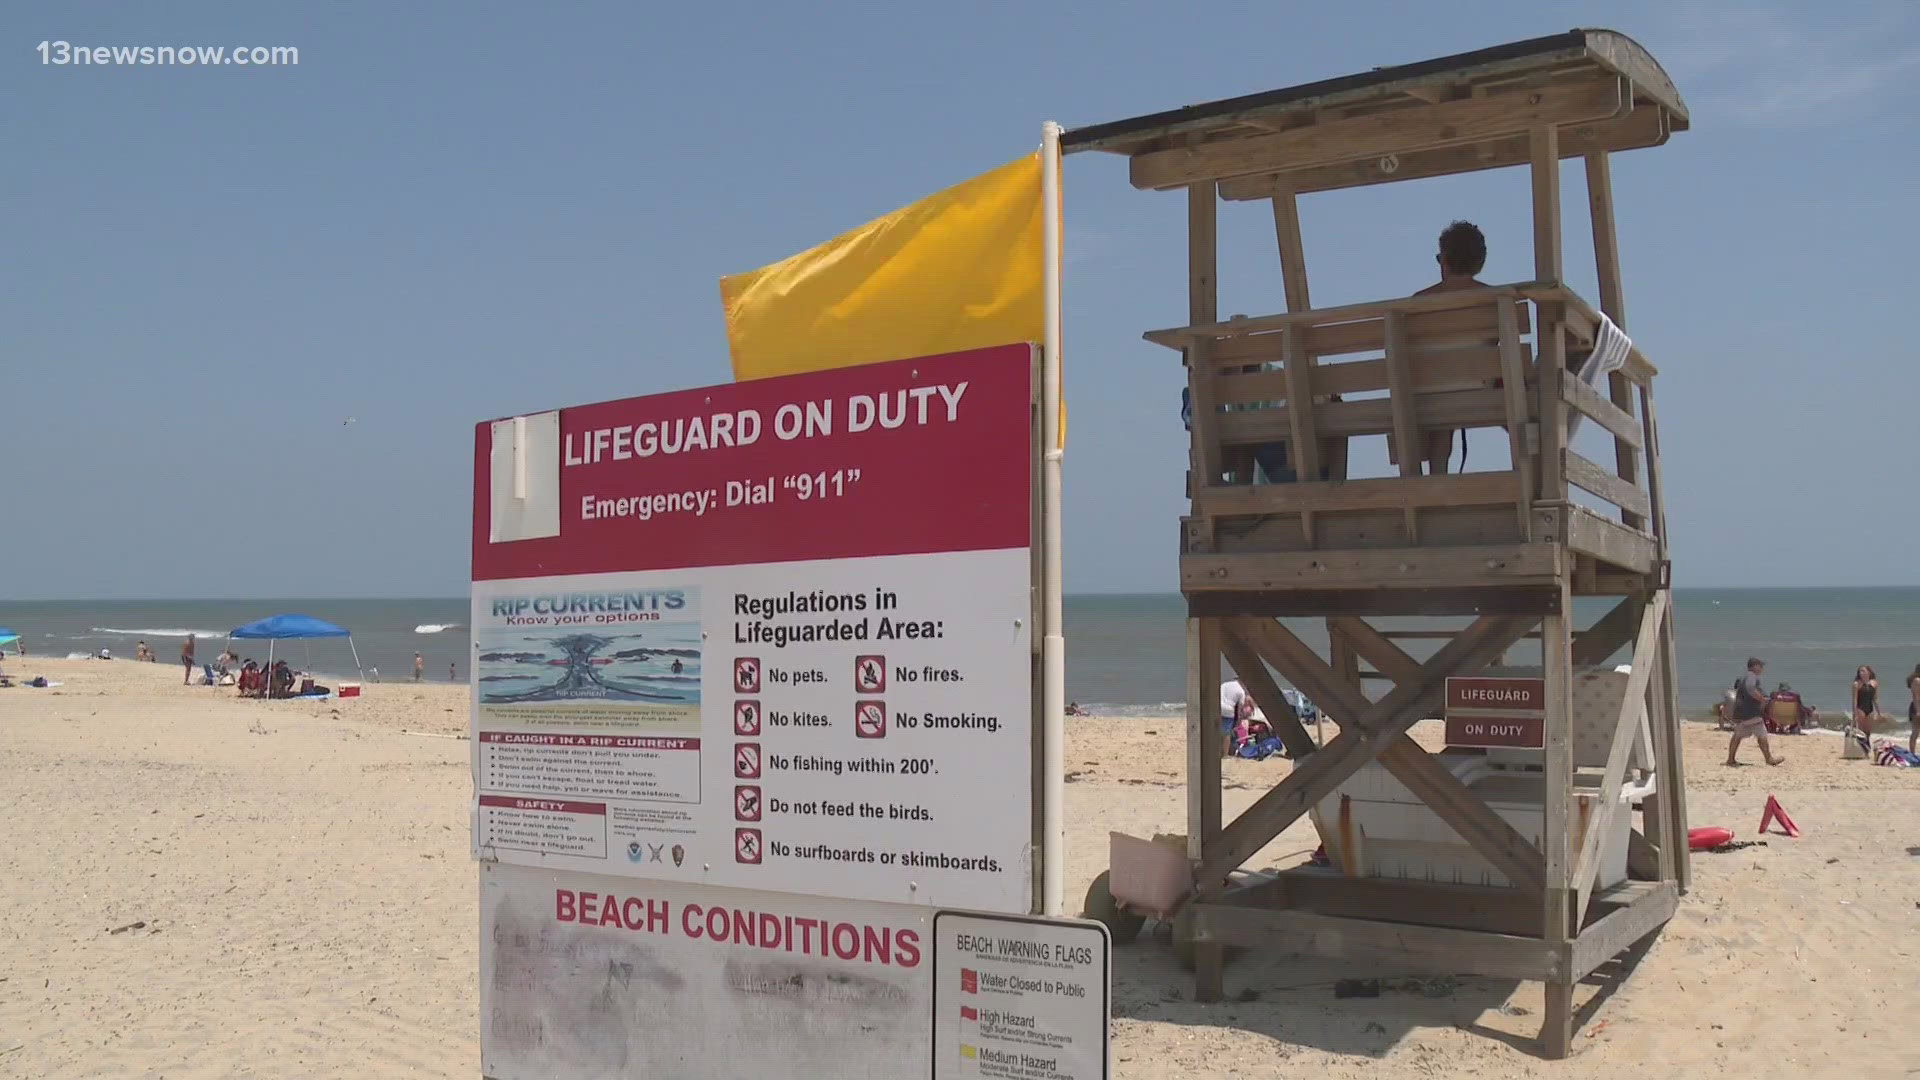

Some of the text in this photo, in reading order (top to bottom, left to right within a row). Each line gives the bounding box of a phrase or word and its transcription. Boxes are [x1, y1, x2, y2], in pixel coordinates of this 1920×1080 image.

[564, 381, 969, 467] LIFEGUARD ON DUTY
[581, 487, 718, 520] Emergency:
[726, 477, 774, 507] Dial
[493, 590, 686, 617] RIP CURRENTS
[734, 587, 897, 619] Regulations in
[507, 611, 660, 626] Know your options
[735, 617, 943, 648] Lifeguarded Area:
[769, 668, 828, 686] No pets.
[895, 666, 964, 682] No fires.
[1461, 689, 1530, 701] LIFEGUARD
[769, 711, 832, 727] No kites.
[896, 713, 1002, 732] No Smoking.
[1465, 724, 1523, 736] ON DUTY
[505, 735, 556, 743] CAUGHT
[577, 737, 586, 745] A
[590, 738, 613, 746] RIP
[617, 739, 687, 748] CURRENT
[769, 755, 789, 770] No
[793, 756, 842, 775] fishing
[847, 758, 895, 774] within
[516, 800, 565, 810] SAFETY
[770, 798, 934, 822] Do not feed the birds.
[771, 841, 1003, 873] No surfboards or skimboards.
[556, 889, 921, 968] BEACH CONDITIONS
[957, 934, 1092, 965] BEACH WARNING FLAGS
[980, 972, 1008, 988] Water
[1009, 976, 1041, 992] Closed
[1044, 981, 1053, 993] to
[1056, 981, 1086, 998] Public
[980, 1008, 1035, 1028] High Hazard
[980, 1048, 1056, 1071] Medium Hazard
